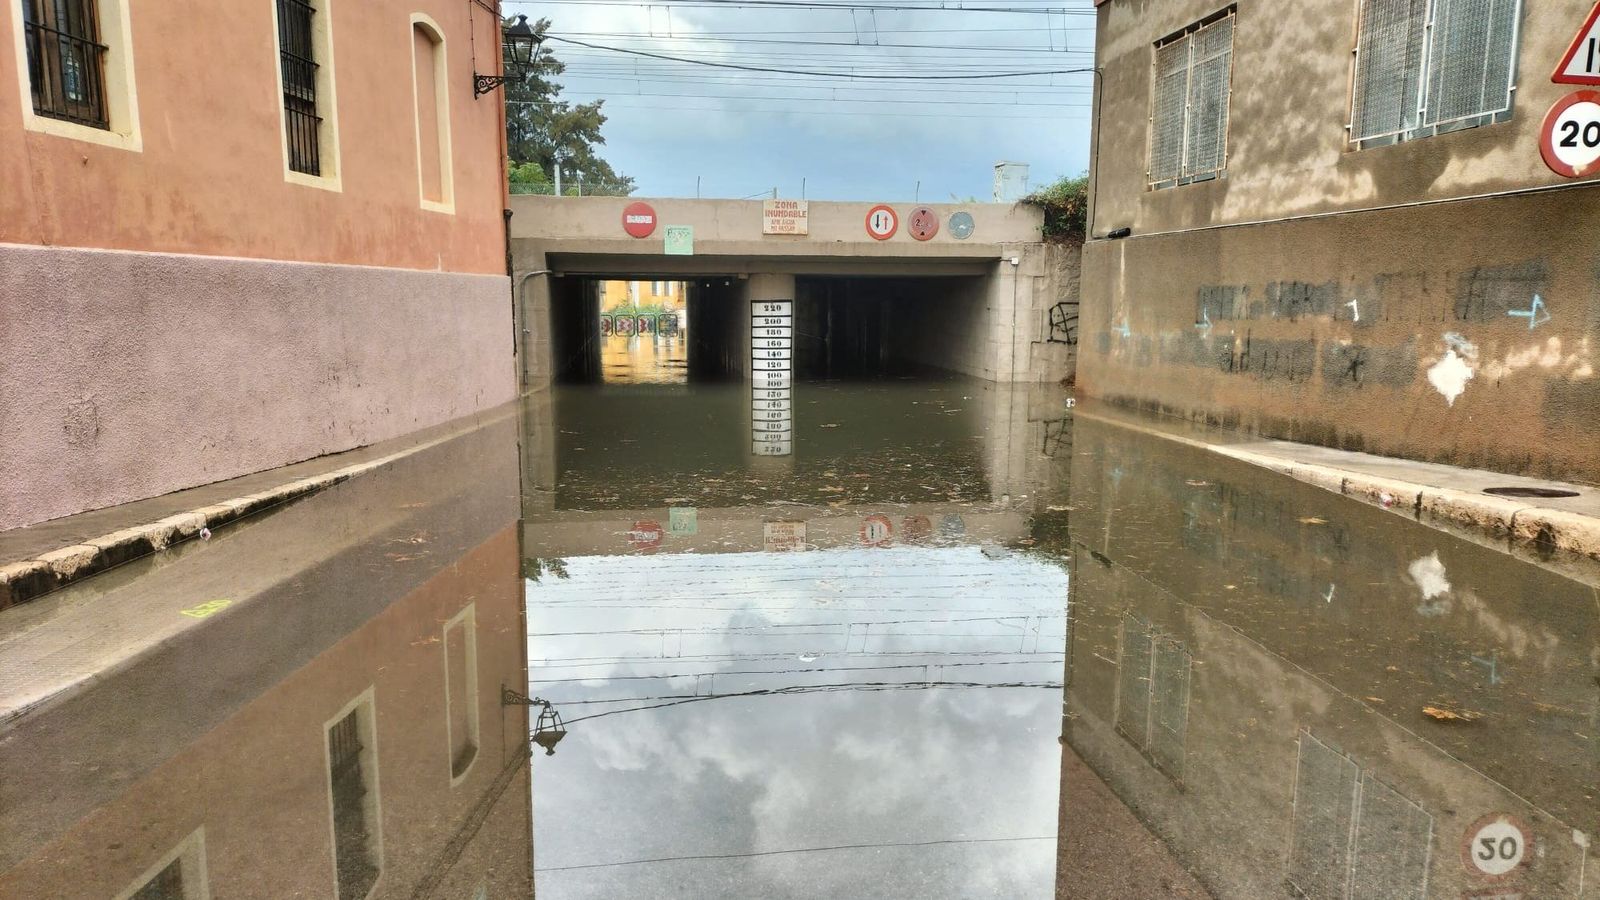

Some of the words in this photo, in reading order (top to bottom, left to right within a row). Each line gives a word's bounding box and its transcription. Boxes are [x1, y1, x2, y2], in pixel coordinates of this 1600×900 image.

[1559, 120, 1600, 148] 20
[774, 200, 798, 209] ZONA
[765, 209, 807, 218] INUNDABLE
[763, 304, 782, 312] 220
